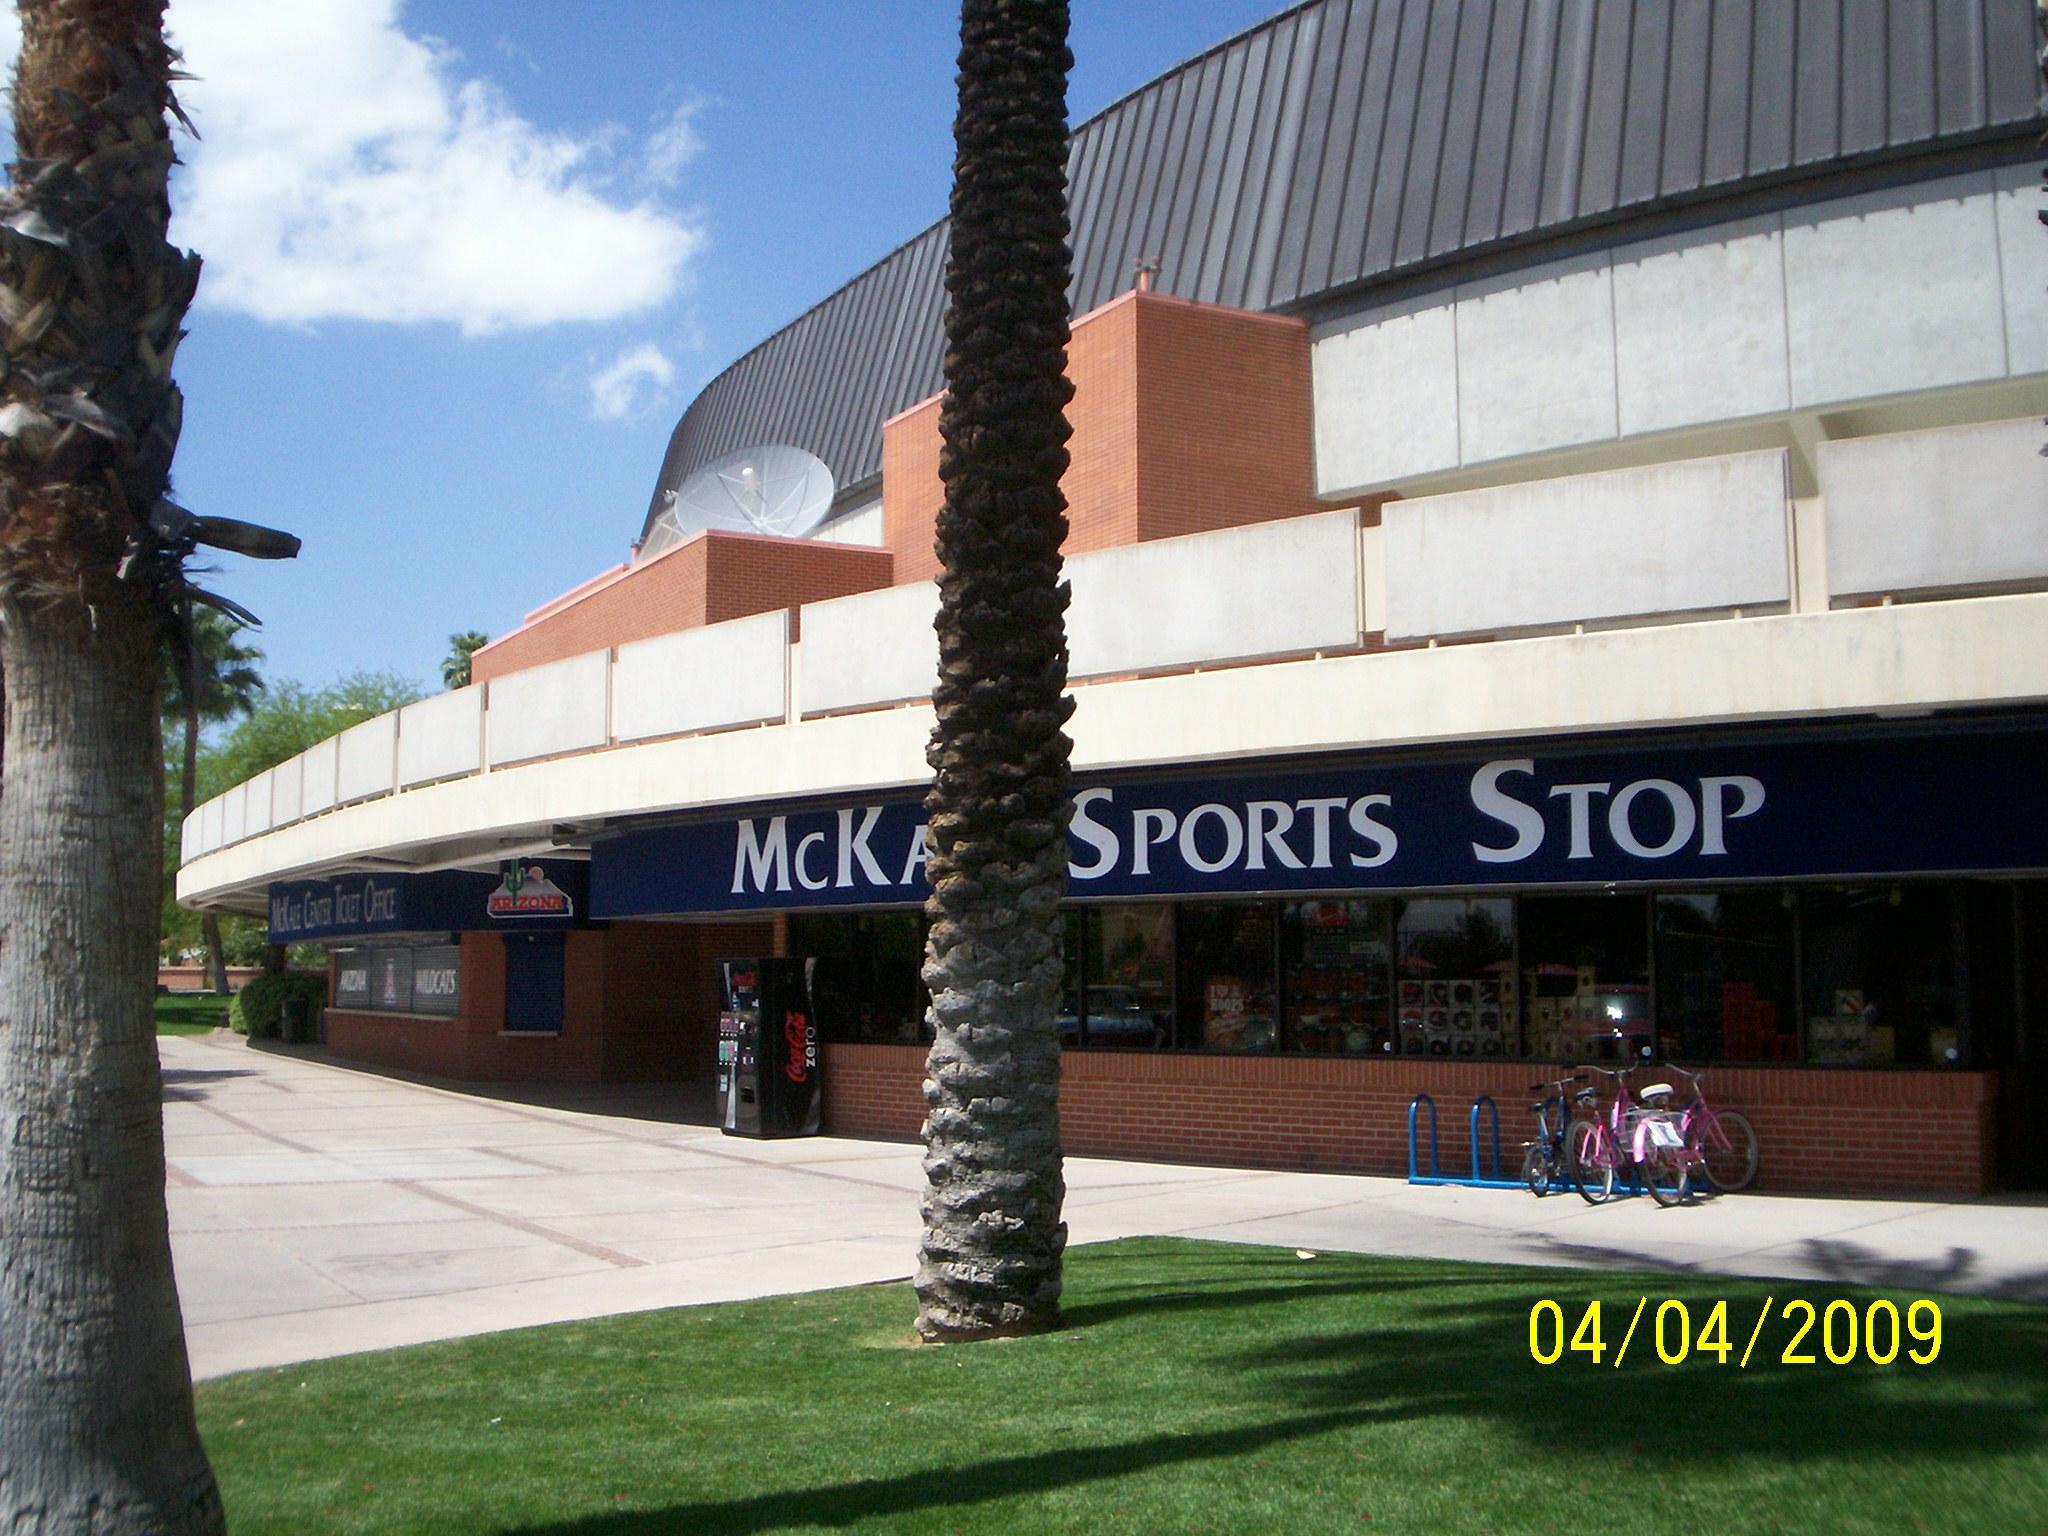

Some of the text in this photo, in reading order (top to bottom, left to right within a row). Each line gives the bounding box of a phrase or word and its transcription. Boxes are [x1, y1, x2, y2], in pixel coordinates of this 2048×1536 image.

[731, 758, 1767, 894] McKA SPORTS STOP
[491, 895, 562, 910] ARIZONA
[805, 1026, 817, 1068] zero
